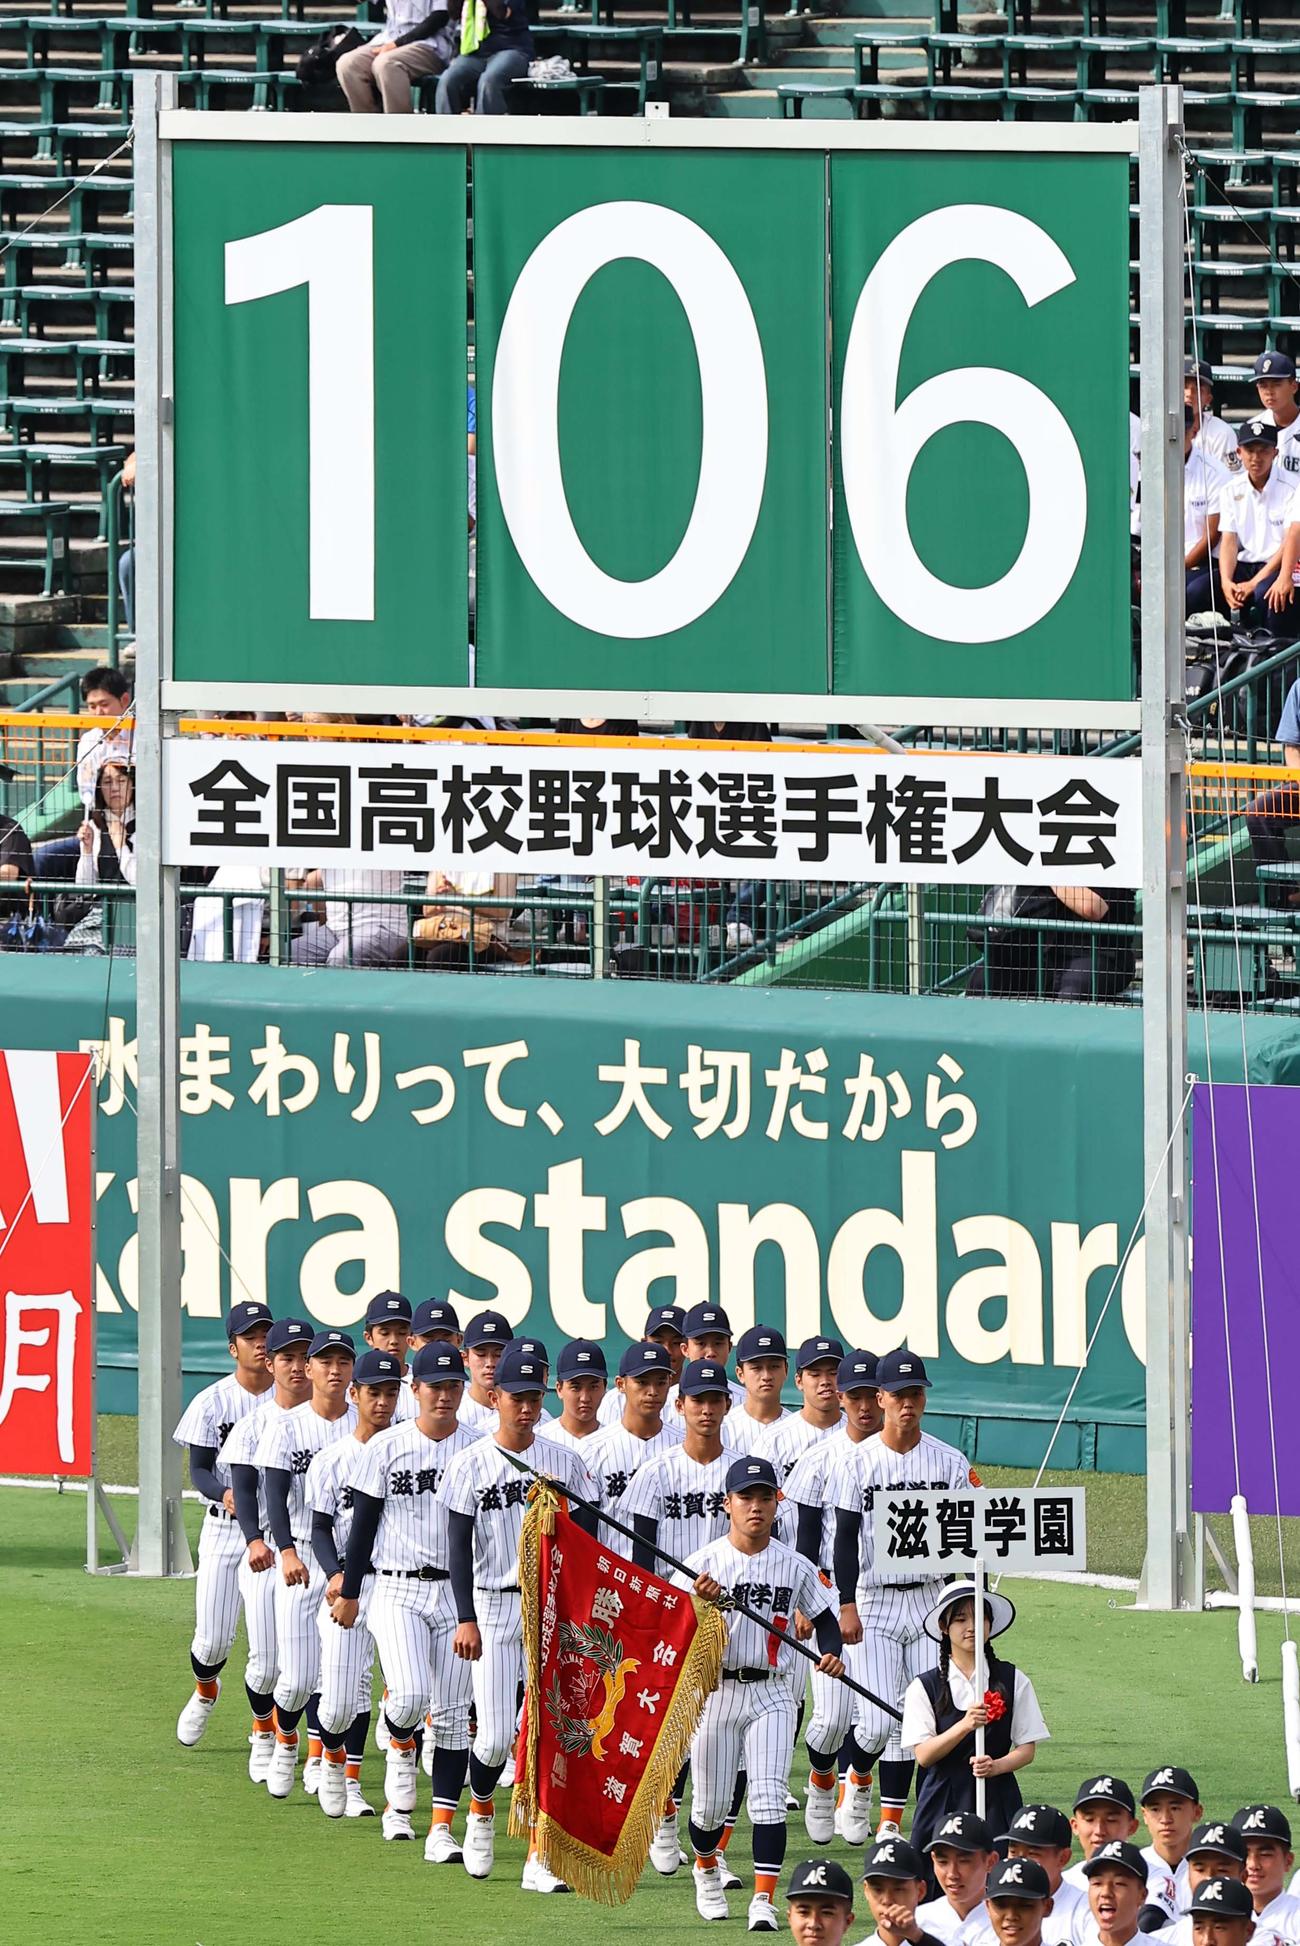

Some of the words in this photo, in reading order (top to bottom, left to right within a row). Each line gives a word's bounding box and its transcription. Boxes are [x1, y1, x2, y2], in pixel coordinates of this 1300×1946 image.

[224, 201, 1088, 645] 106
[189, 759, 1120, 870] 全国高校野球選手権大会
[79, 1016, 978, 1151] 水まわりって、大切だから
[391, 1468, 446, 1497] 滋賀
[747, 1465, 761, 1474] S
[886, 1497, 1075, 1560] 滋賀学園
[596, 1554, 679, 1610] 朝日新聞社
[718, 1582, 793, 1616] 賀学園
[603, 1639, 677, 1805] 滋賀大会
